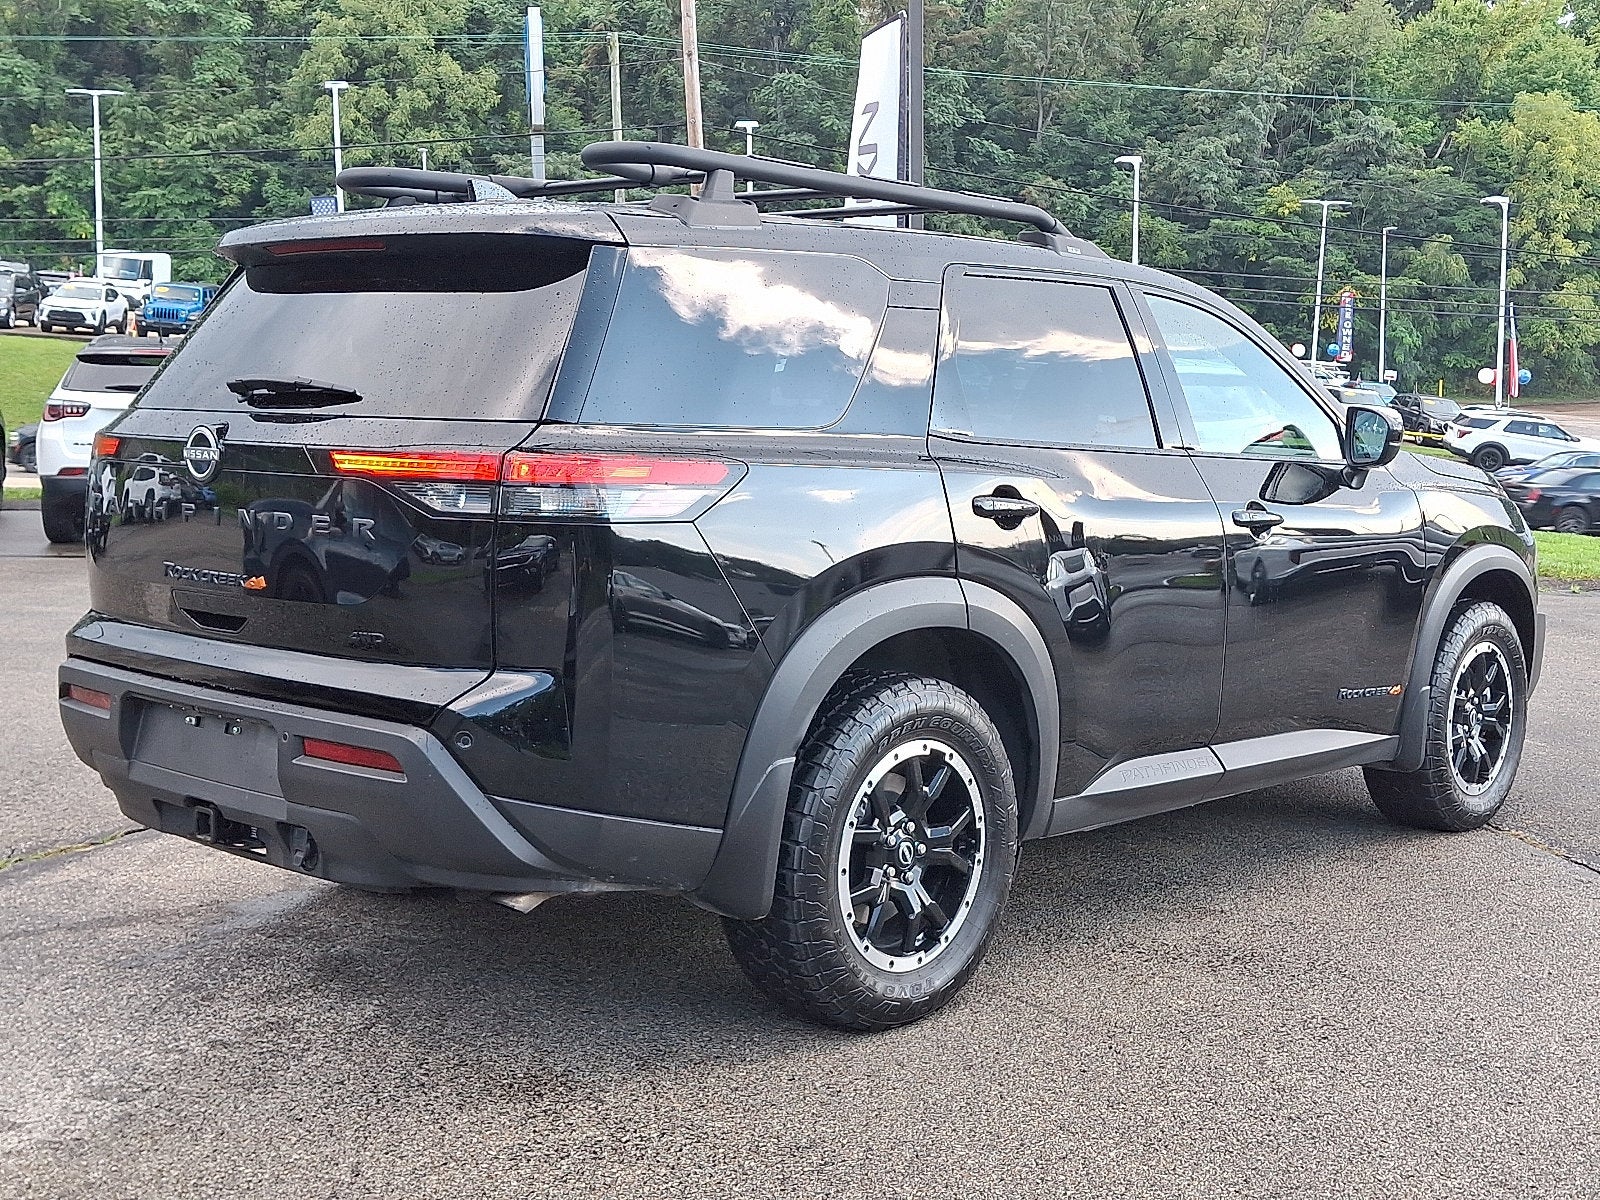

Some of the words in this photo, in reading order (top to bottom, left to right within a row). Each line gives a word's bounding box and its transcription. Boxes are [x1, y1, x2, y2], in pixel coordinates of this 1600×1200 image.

[1340, 321, 1353, 358] OWNED
[183, 448, 219, 461] NISSAN
[1119, 755, 1217, 783] PATHFINDER
